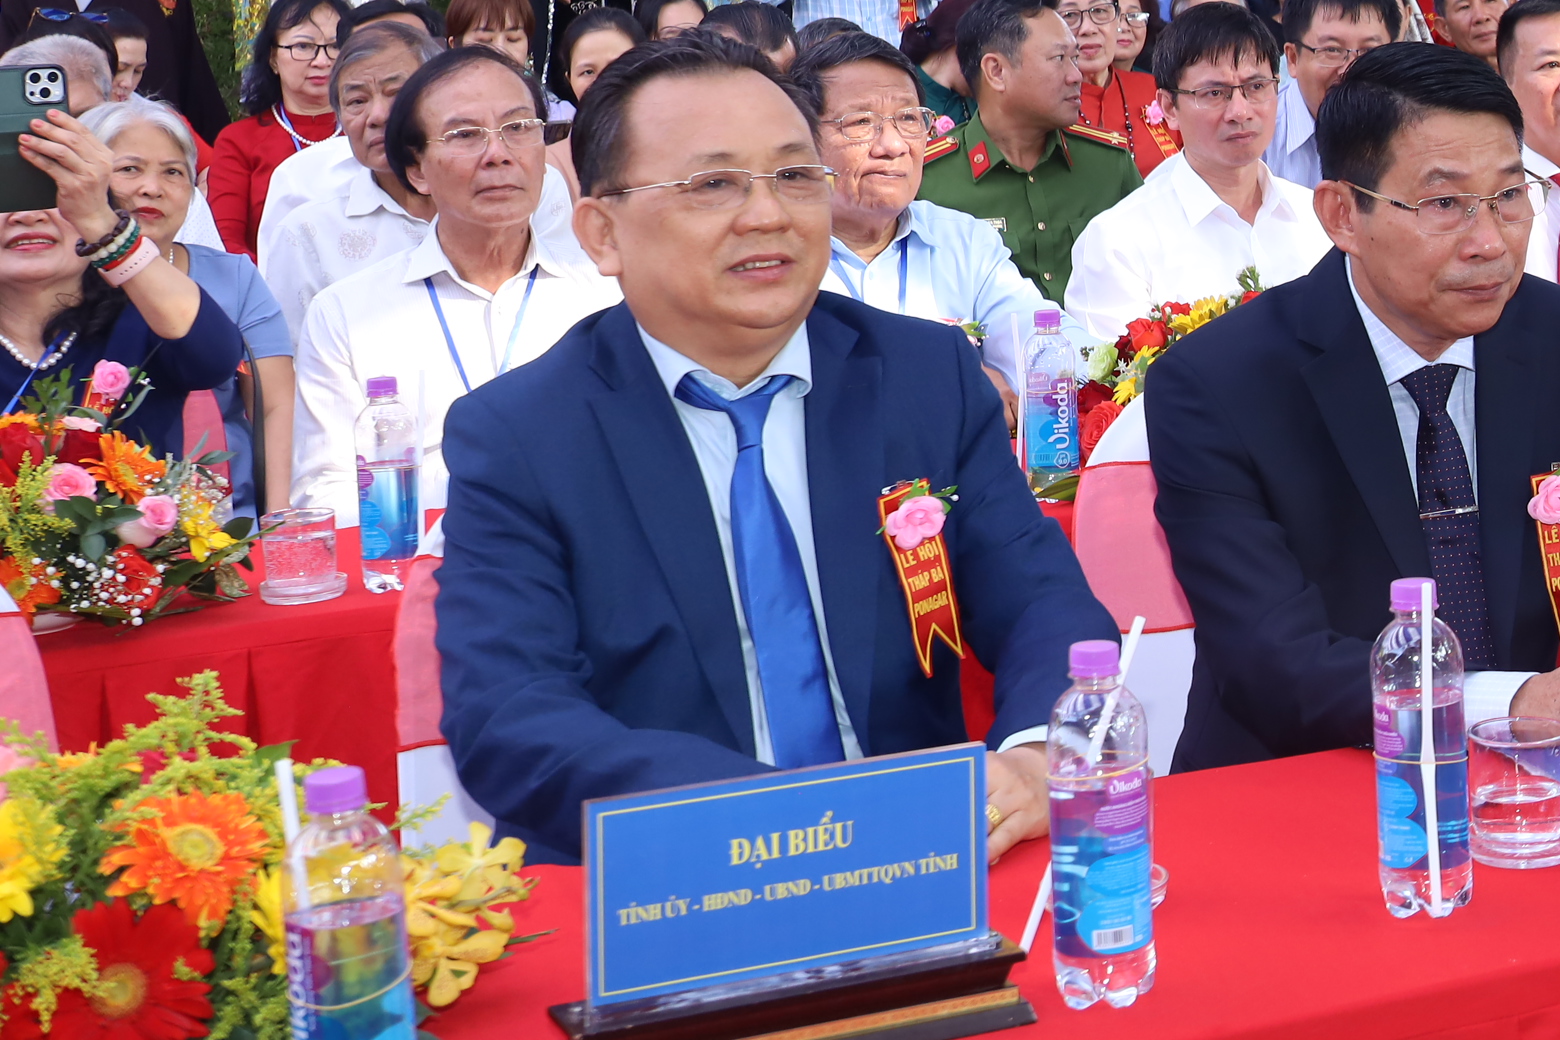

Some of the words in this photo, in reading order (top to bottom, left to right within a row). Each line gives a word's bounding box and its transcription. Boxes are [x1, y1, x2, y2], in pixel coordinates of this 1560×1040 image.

[916, 539, 940, 561] HỘI
[908, 569, 931, 593] THÁP
[930, 562, 945, 583] BÀ
[914, 591, 949, 619] PONAGAR
[729, 832, 782, 869] ĐẠI
[787, 810, 854, 857] BIỂU
[617, 901, 664, 926] TỈNH
[664, 895, 692, 918] ỦY
[702, 888, 753, 912] HĐND
[763, 878, 812, 901] UBND
[822, 860, 916, 891] UBMTTQVN
[918, 852, 959, 875] TỈNH
